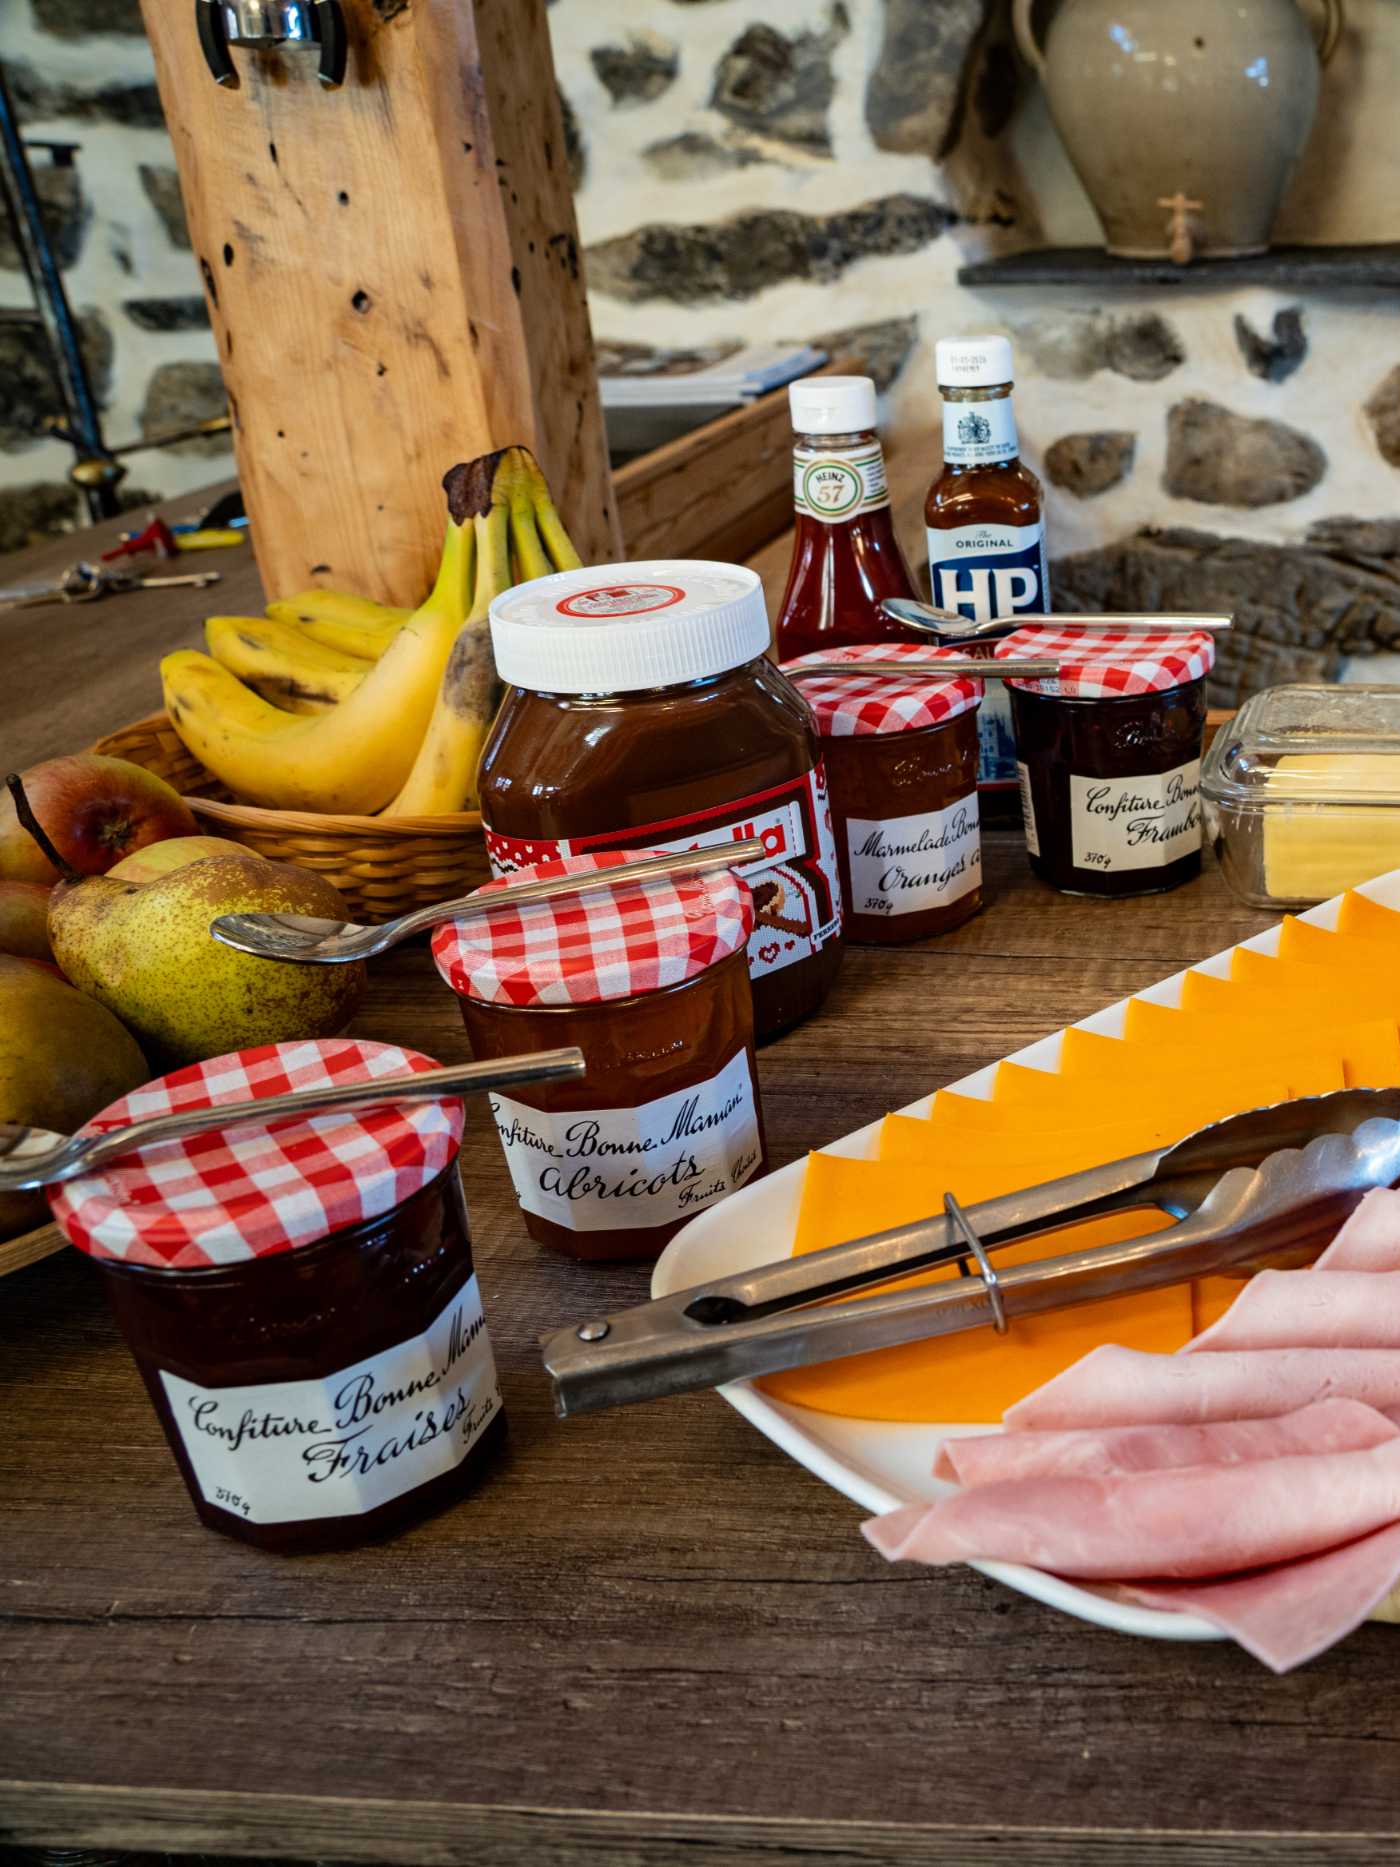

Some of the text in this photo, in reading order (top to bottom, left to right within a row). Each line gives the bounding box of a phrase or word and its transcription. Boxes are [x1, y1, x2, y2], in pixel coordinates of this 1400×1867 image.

[816, 472, 846, 484] HEINZ
[817, 485, 845, 504] 57
[955, 539, 1014, 549] ORIGINAL
[938, 566, 1039, 625] HP
[1085, 786, 1166, 821] Confiture
[854, 824, 952, 858] Marmelade
[878, 853, 967, 893] Oranges
[565, 1119, 658, 1158] Bonne
[660, 1093, 743, 1145] Maman
[678, 1179, 726, 1209] Fruits
[188, 1395, 332, 1451] Confiture
[333, 1371, 441, 1429] Bonne
[302, 1385, 469, 1483] Fraises
